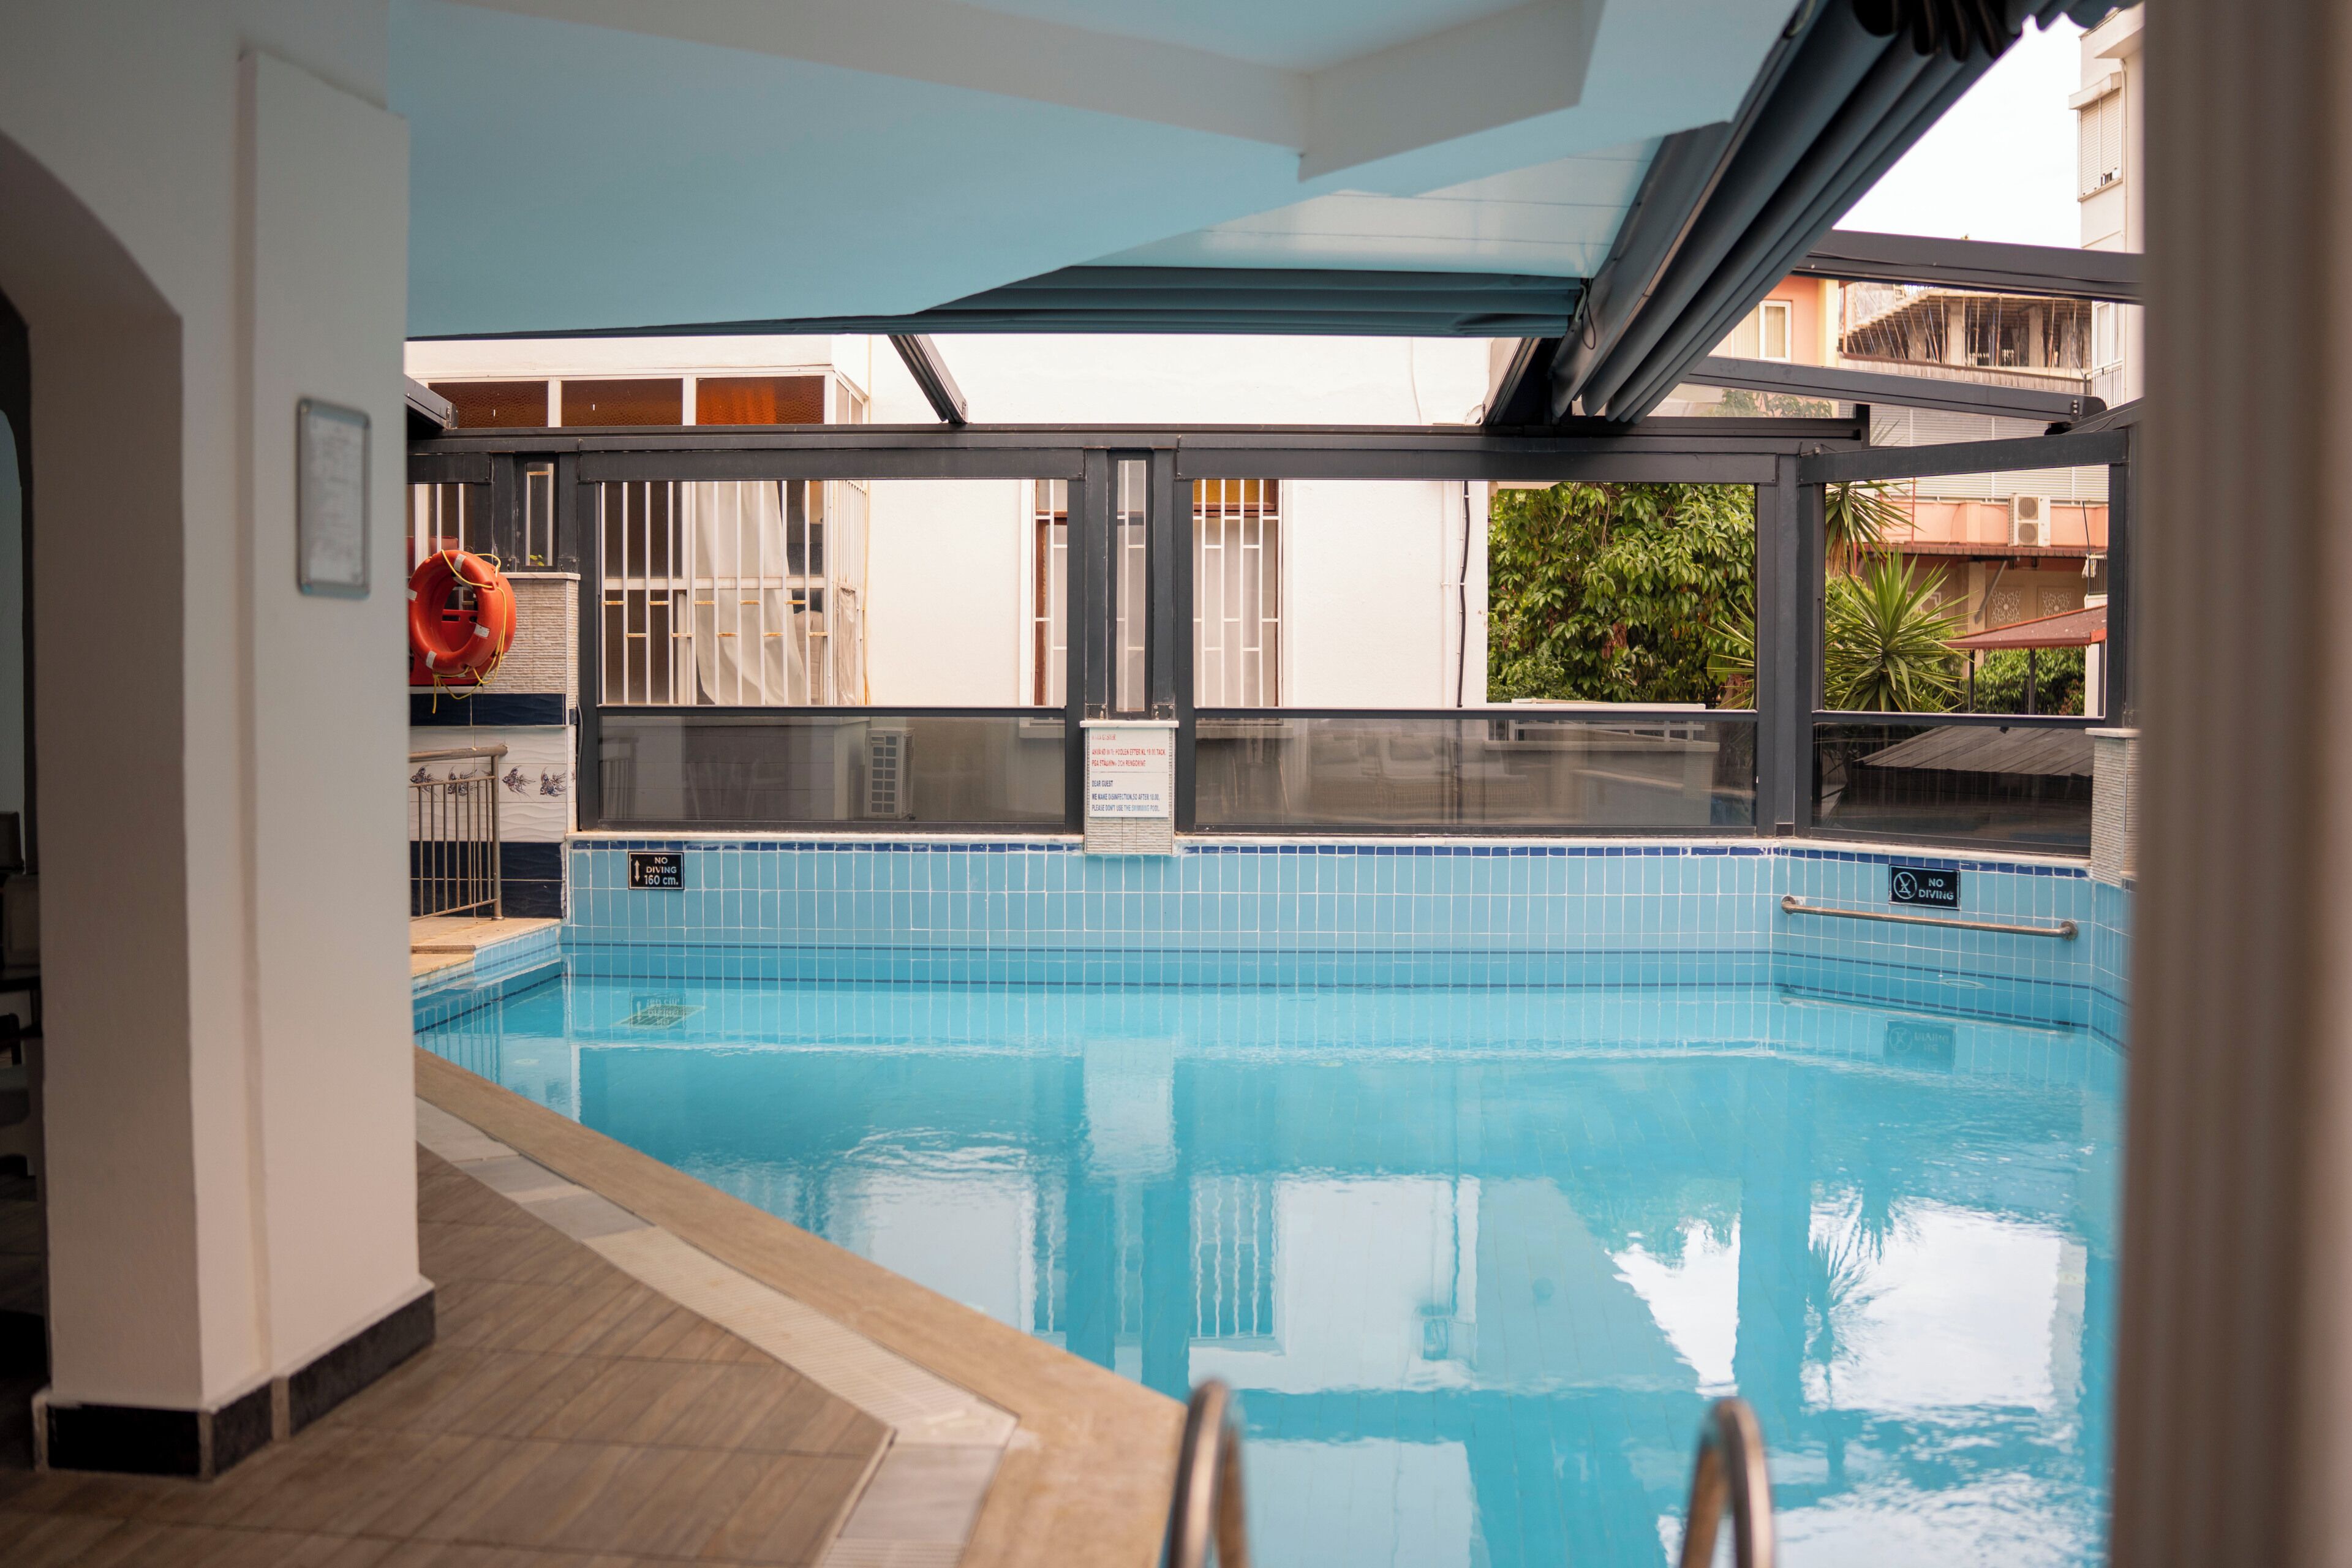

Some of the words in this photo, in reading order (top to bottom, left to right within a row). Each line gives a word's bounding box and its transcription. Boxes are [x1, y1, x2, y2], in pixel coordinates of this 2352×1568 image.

[644, 875, 660, 885] 160
[662, 876, 679, 885] cm.
[1928, 878, 1944, 888] NO
[1918, 889, 1954, 900] DIVING
